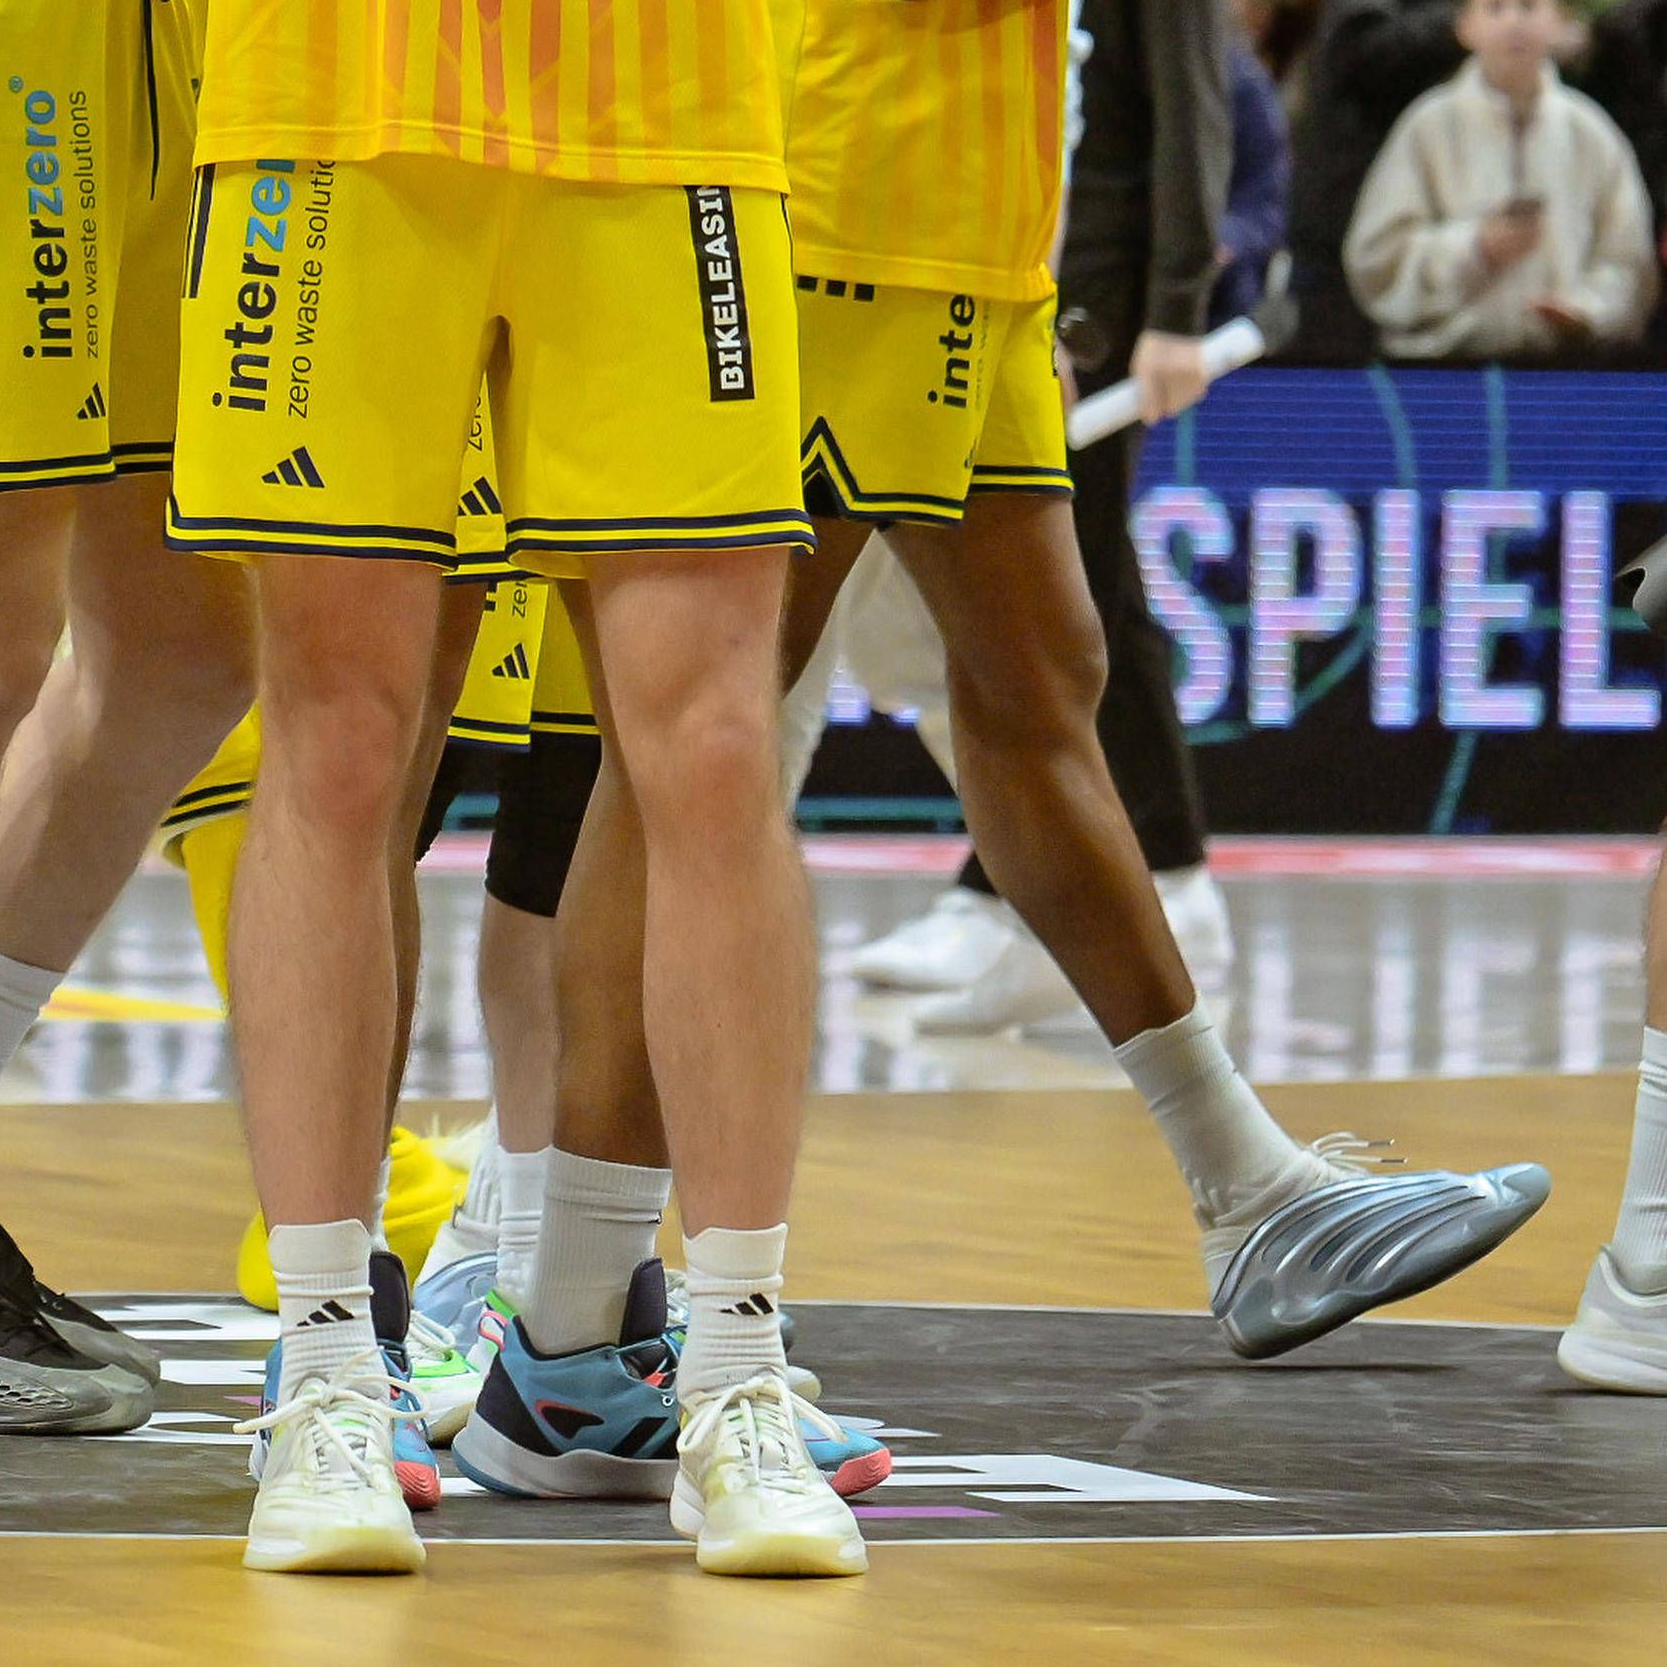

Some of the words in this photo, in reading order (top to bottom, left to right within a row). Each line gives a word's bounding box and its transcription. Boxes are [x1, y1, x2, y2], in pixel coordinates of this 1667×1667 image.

[69, 90, 98, 210] solutions
[23, 89, 73, 358] interzero
[79, 219, 98, 297] waste
[85, 303, 99, 360] zero
[294, 259, 324, 346] waste
[287, 354, 313, 419] zero
[1127, 485, 1662, 728] SPIEL
